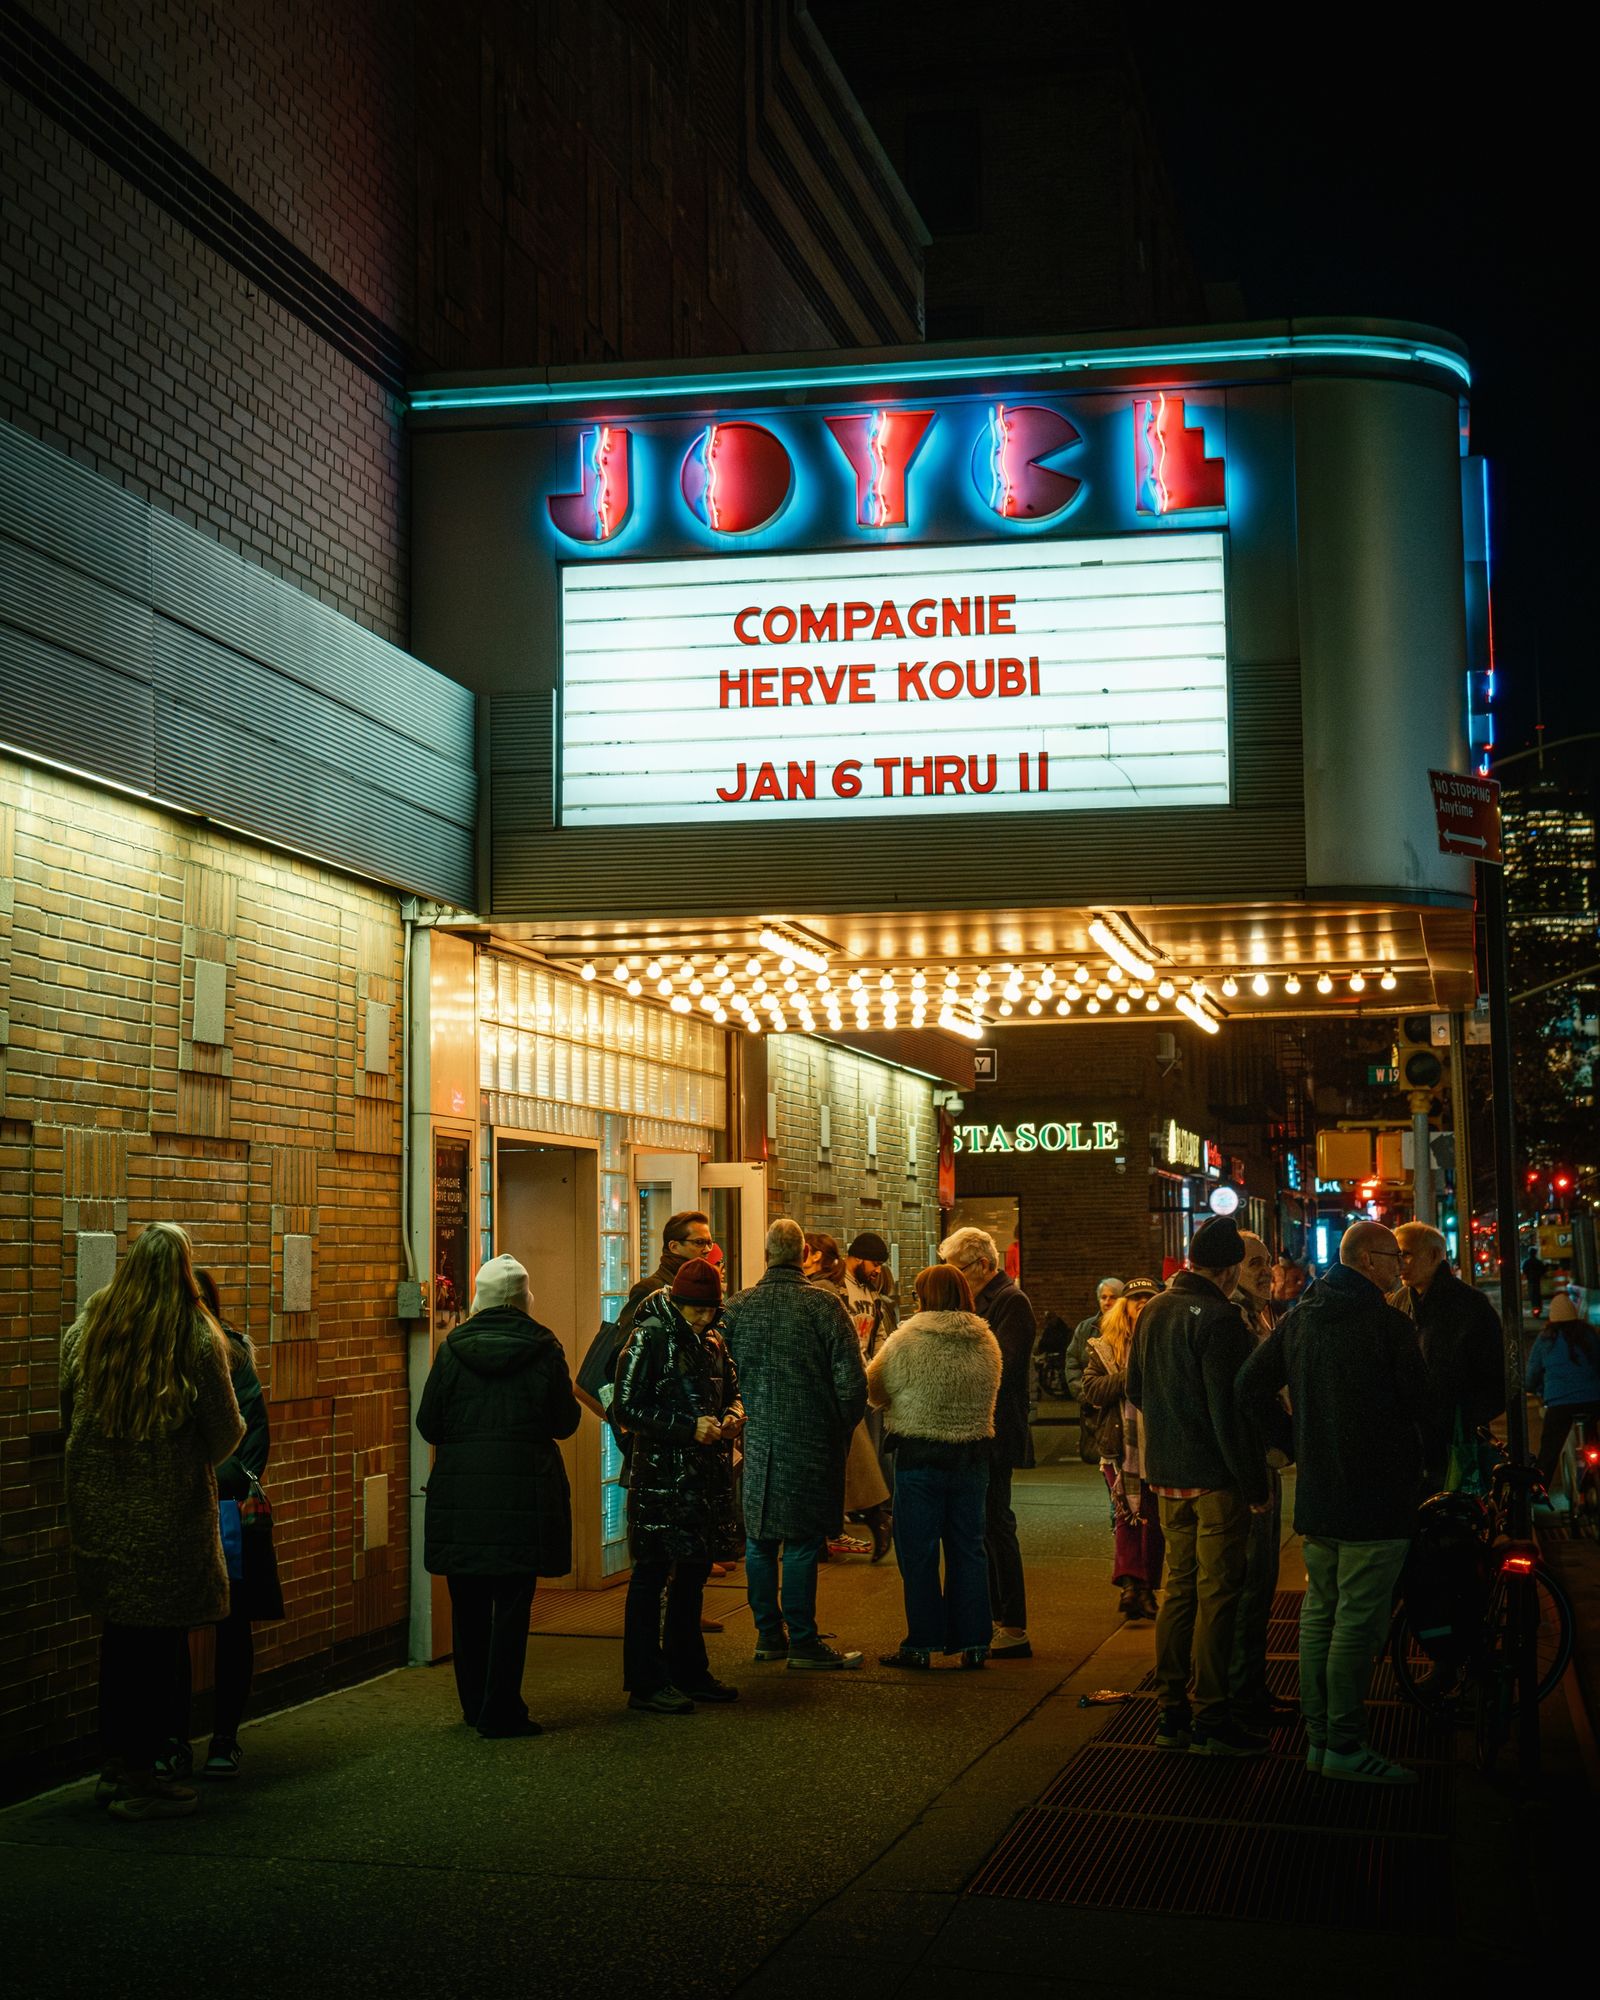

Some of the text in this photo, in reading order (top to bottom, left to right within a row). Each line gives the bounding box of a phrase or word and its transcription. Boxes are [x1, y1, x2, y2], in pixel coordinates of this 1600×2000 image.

[547, 394, 1227, 543] JOYCE
[734, 594, 1016, 645] COMPAGNIE
[719, 656, 1041, 709] HERVE KOUBI
[716, 760, 816, 802] JAN
[831, 759, 863, 799] 6
[874, 754, 997, 797] THRU
[1434, 779, 1491, 803] NO STOPPING
[1440, 798, 1473, 818] Anytime
[1375, 1068, 1385, 1082] W
[1129, 1280, 1152, 1289] ELTON
